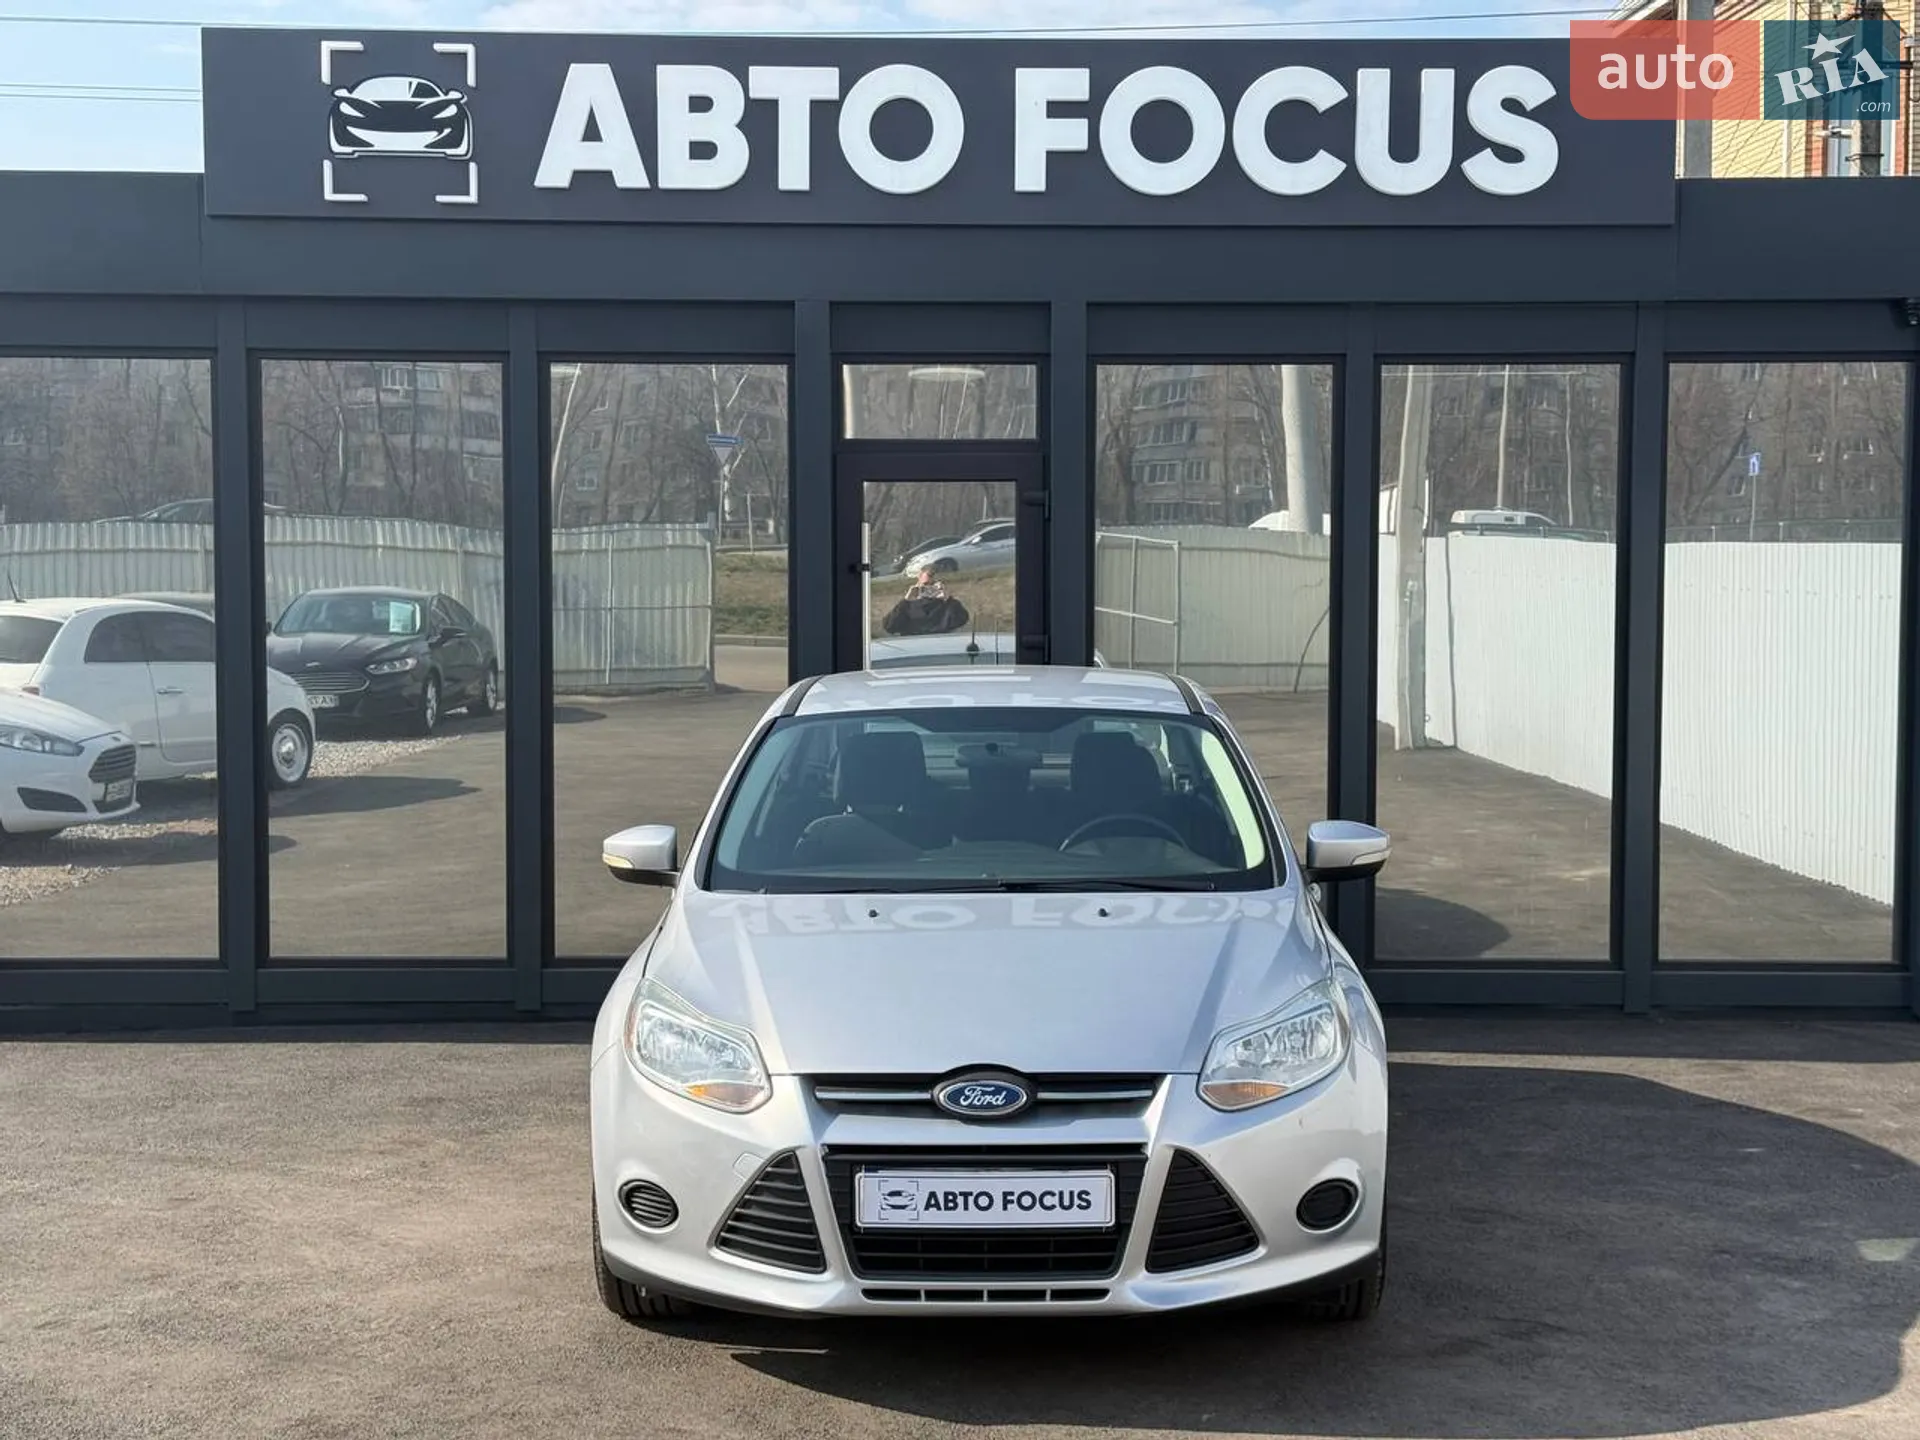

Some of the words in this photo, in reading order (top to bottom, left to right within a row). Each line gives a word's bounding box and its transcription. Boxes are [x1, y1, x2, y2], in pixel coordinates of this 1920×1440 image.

[534, 63, 965, 194] АВТО
[1014, 65, 1559, 195] FOCUS
[960, 1086, 1006, 1106] Ford
[924, 1191, 994, 1212] АВТО
[1002, 1190, 1092, 1212] FOCUS
